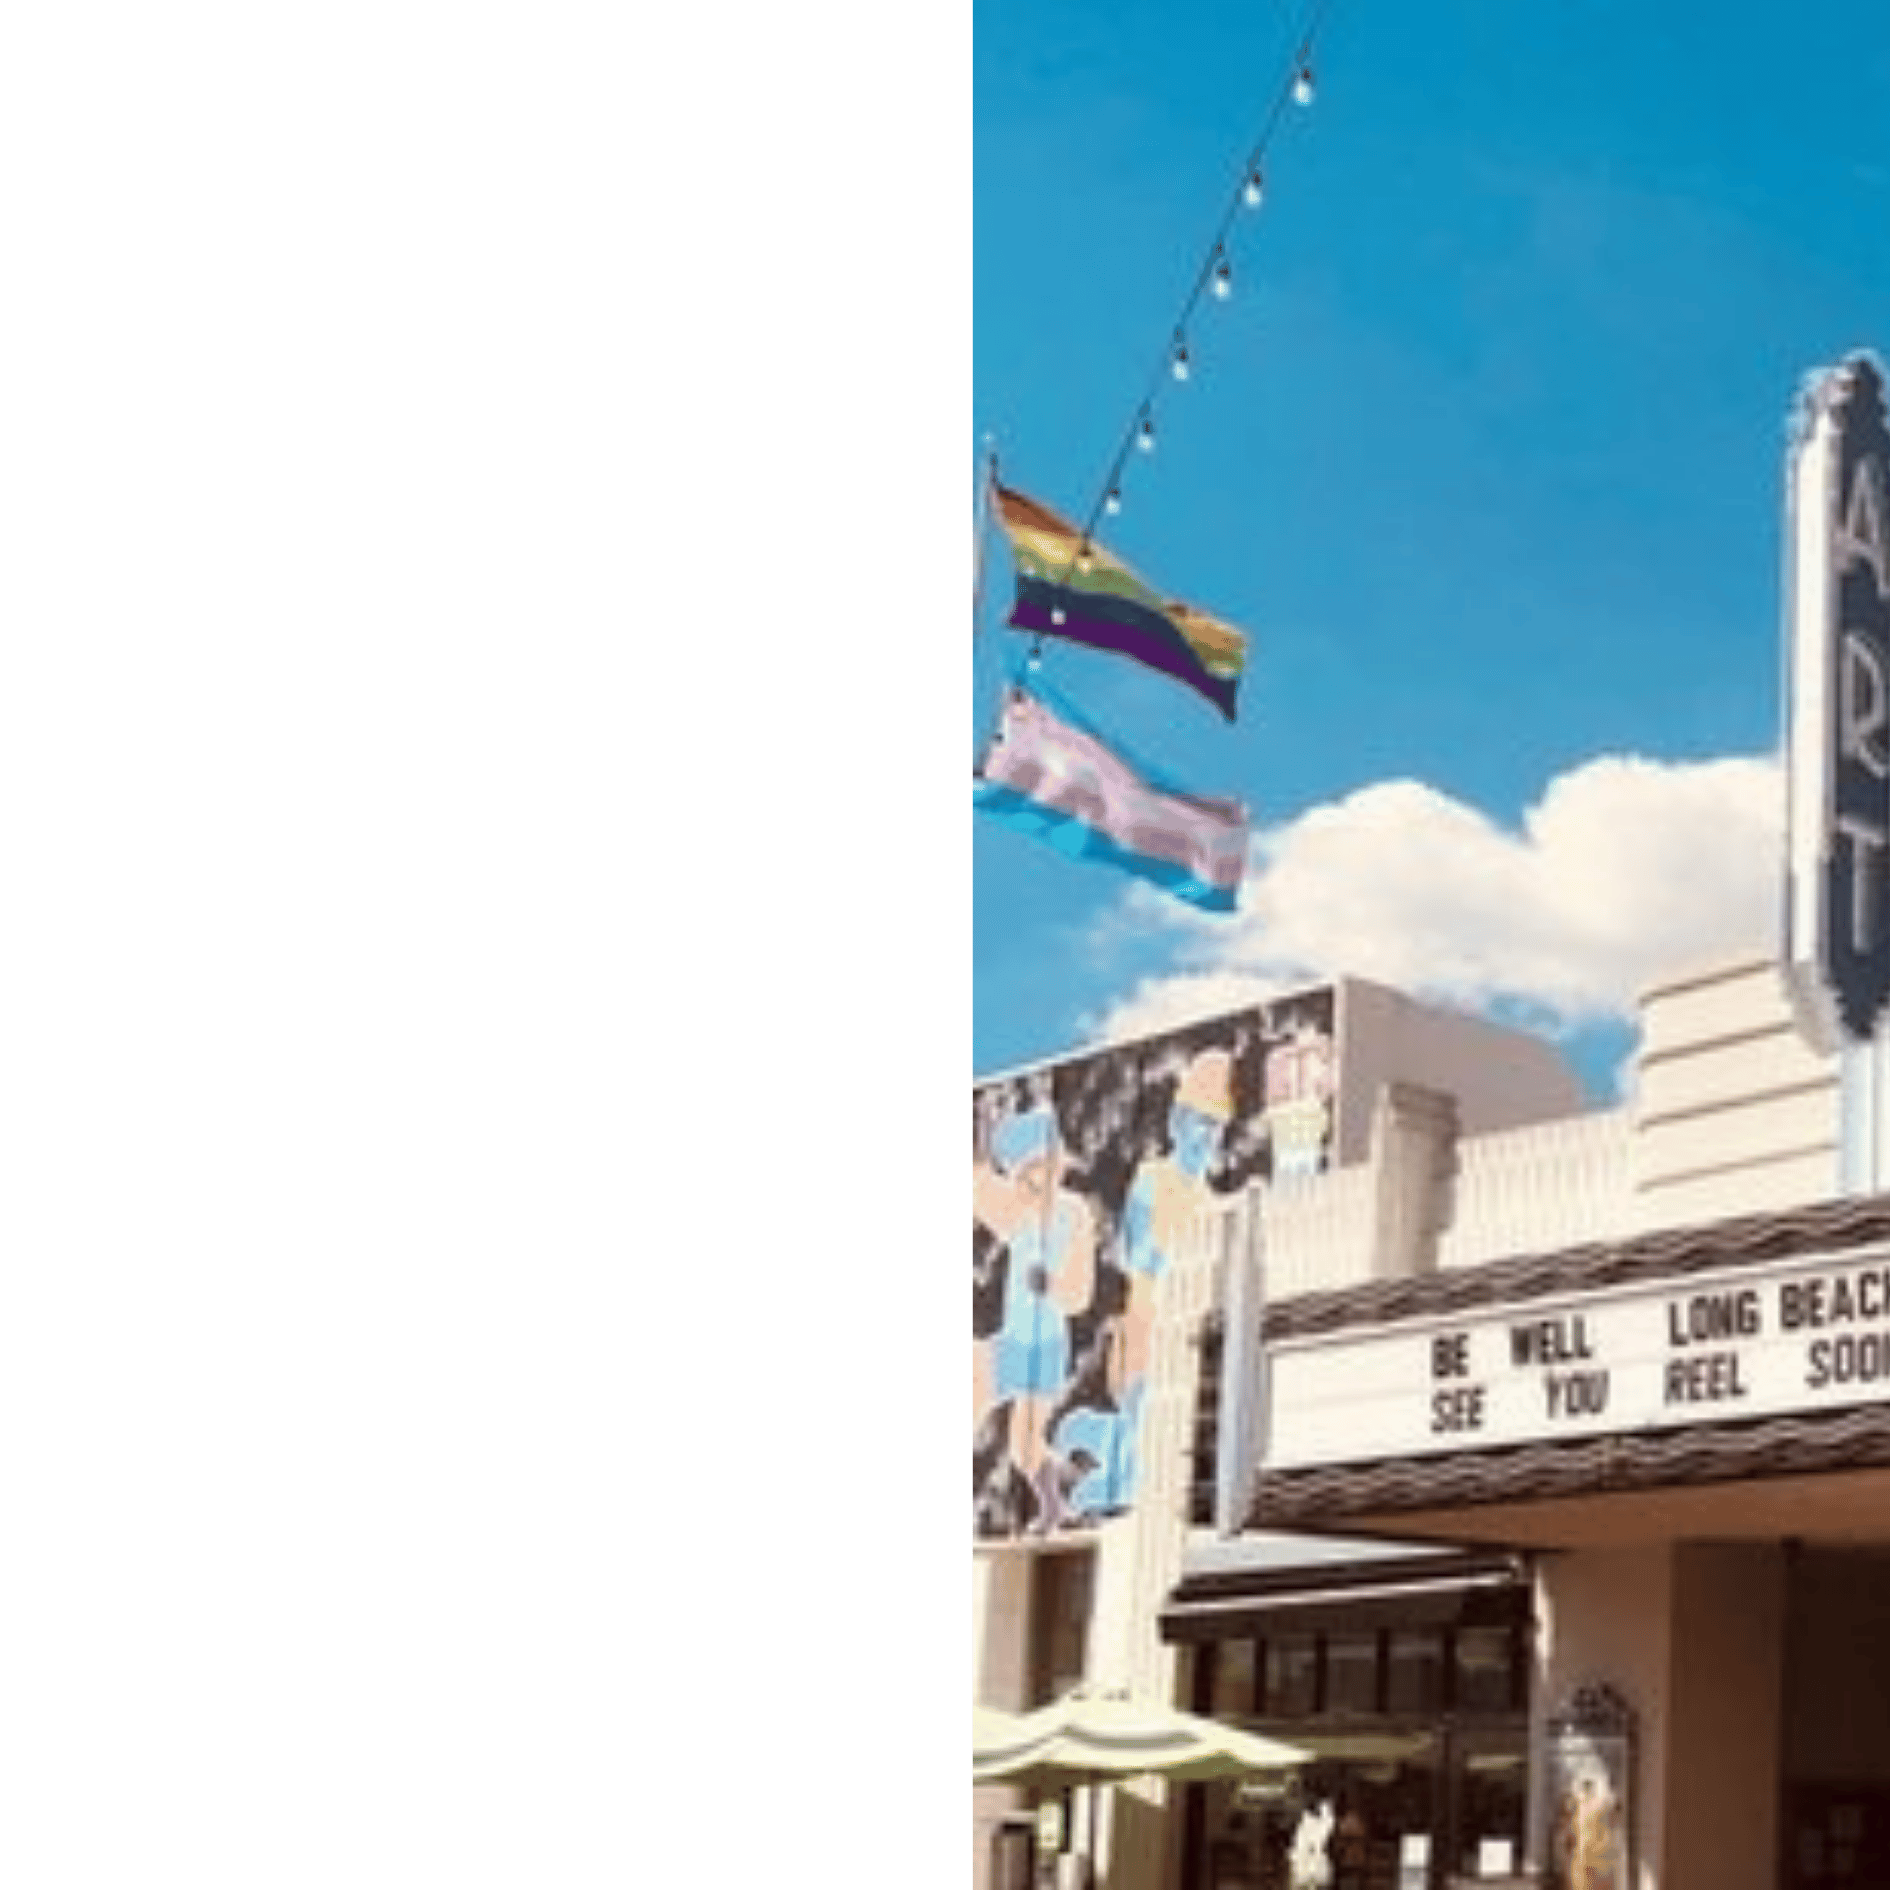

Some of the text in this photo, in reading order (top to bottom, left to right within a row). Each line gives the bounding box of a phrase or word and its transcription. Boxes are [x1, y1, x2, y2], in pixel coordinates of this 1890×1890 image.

[1432, 1331, 1469, 1378] BE
[1510, 1315, 1592, 1366] WELL
[1669, 1290, 1758, 1347] LONG
[1431, 1382, 1486, 1434] SEE
[1544, 1369, 1611, 1420] YOU
[1664, 1350, 1746, 1406] REEL
